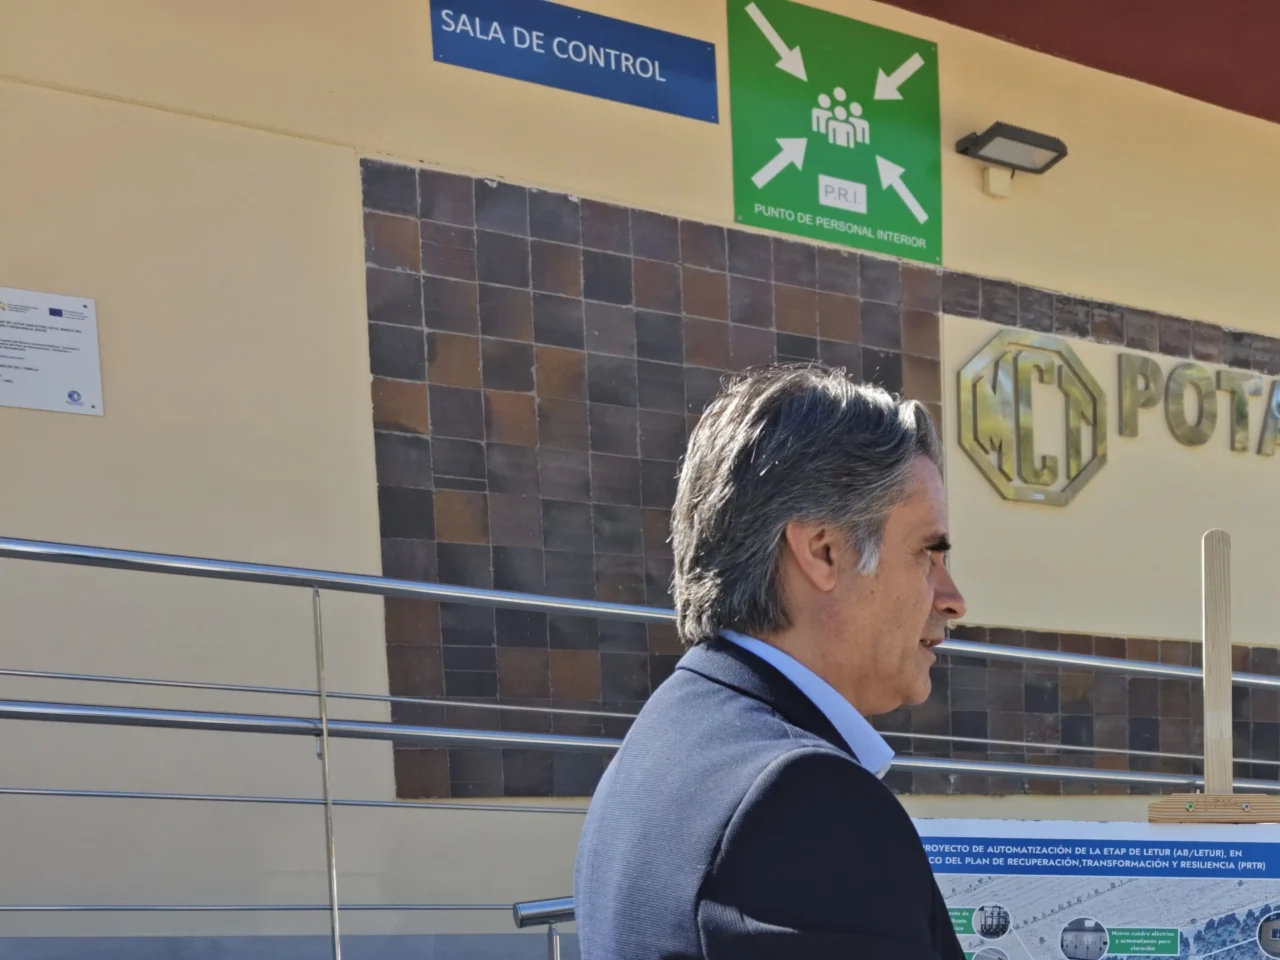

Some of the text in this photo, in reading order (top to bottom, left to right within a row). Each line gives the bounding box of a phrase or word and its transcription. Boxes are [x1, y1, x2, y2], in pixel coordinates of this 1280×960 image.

[441, 10, 666, 82] SALA DE CONTROL
[824, 184, 861, 205] P.R.I.
[754, 203, 927, 249] PUNTO DE PERSONAL INTERIOR
[972, 845, 984, 853] DE
[987, 845, 1072, 855] AUTOMATIZACIÓN
[1075, 847, 1087, 855] DE
[1089, 847, 1101, 855] LA
[1104, 847, 1126, 856] ETAP
[1129, 848, 1141, 856] DE
[1144, 848, 1171, 856] LETUR
[1173, 848, 1227, 859] (AB/LETUR),
[1229, 849, 1242, 857] EN
[945, 856, 962, 865] DEL
[965, 857, 990, 865] PLAN
[992, 858, 1004, 866] DE
[1180, 861, 1235, 869] RESILIENCIA
[1238, 861, 1266, 871] (PRTR)
